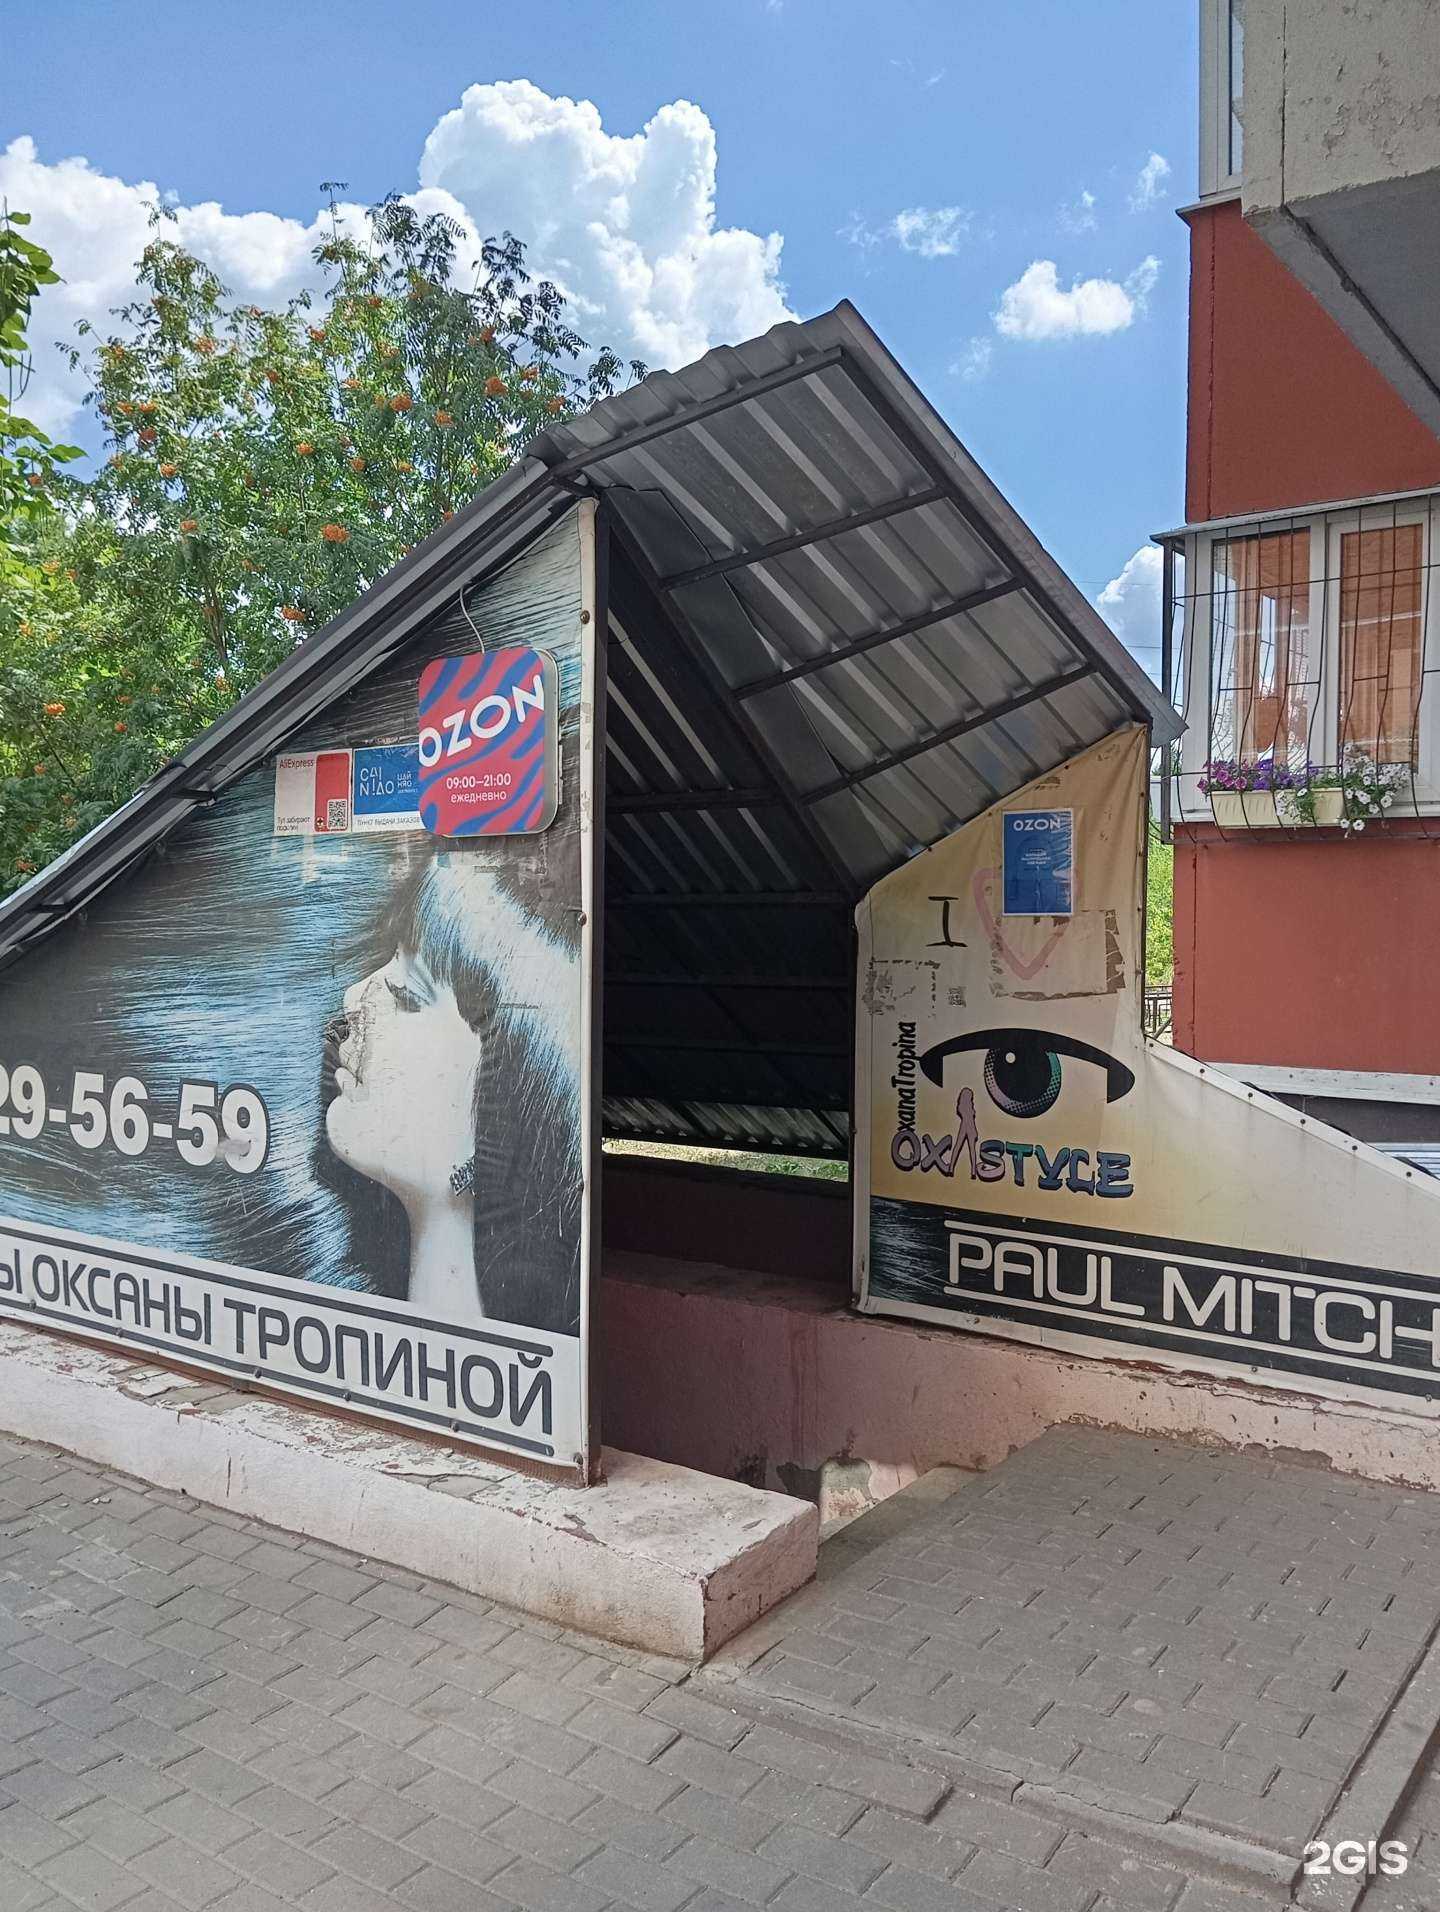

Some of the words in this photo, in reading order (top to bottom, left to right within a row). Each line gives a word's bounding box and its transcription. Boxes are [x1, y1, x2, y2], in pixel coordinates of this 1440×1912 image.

[419, 674, 545, 768] OZON
[279, 758, 315, 769] AliExpress
[450, 790, 507, 804] ежедневно
[1013, 819, 1060, 831] OZON
[949, 1233, 1146, 1317] PAUL
[1162, 1266, 1440, 1367] MITCH
[32, 1254, 212, 1345] ОКСАНЫ
[224, 1298, 553, 1436] ТРОПИНОЙ
